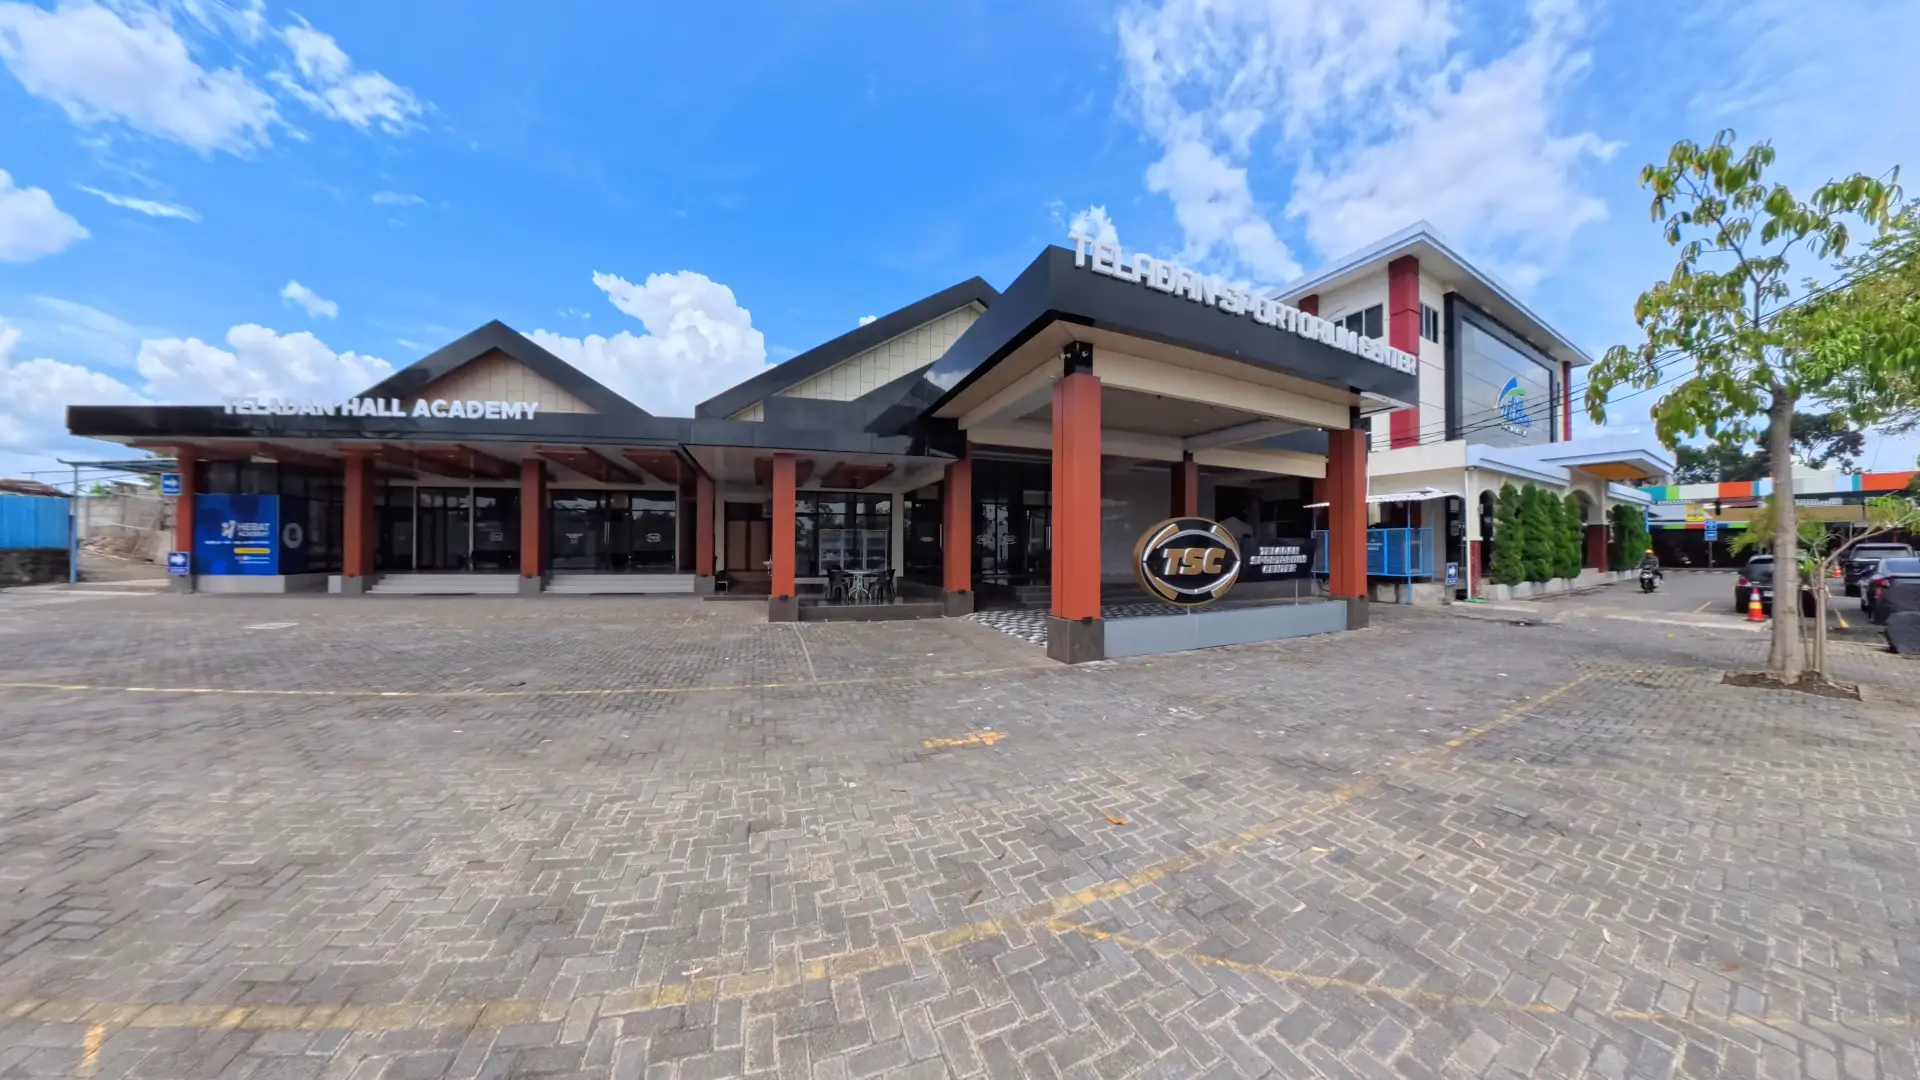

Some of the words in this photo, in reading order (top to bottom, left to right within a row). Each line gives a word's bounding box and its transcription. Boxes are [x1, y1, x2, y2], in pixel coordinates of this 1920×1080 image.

[1068, 230, 1216, 306] TELADAN
[1218, 285, 1358, 354] SPORTORIUM
[1357, 335, 1417, 376] CENTER
[222, 397, 336, 415] TELADAN
[341, 397, 407, 418] HALL
[411, 398, 539, 420] ACADEMY
[1163, 547, 1226, 576] TSC
